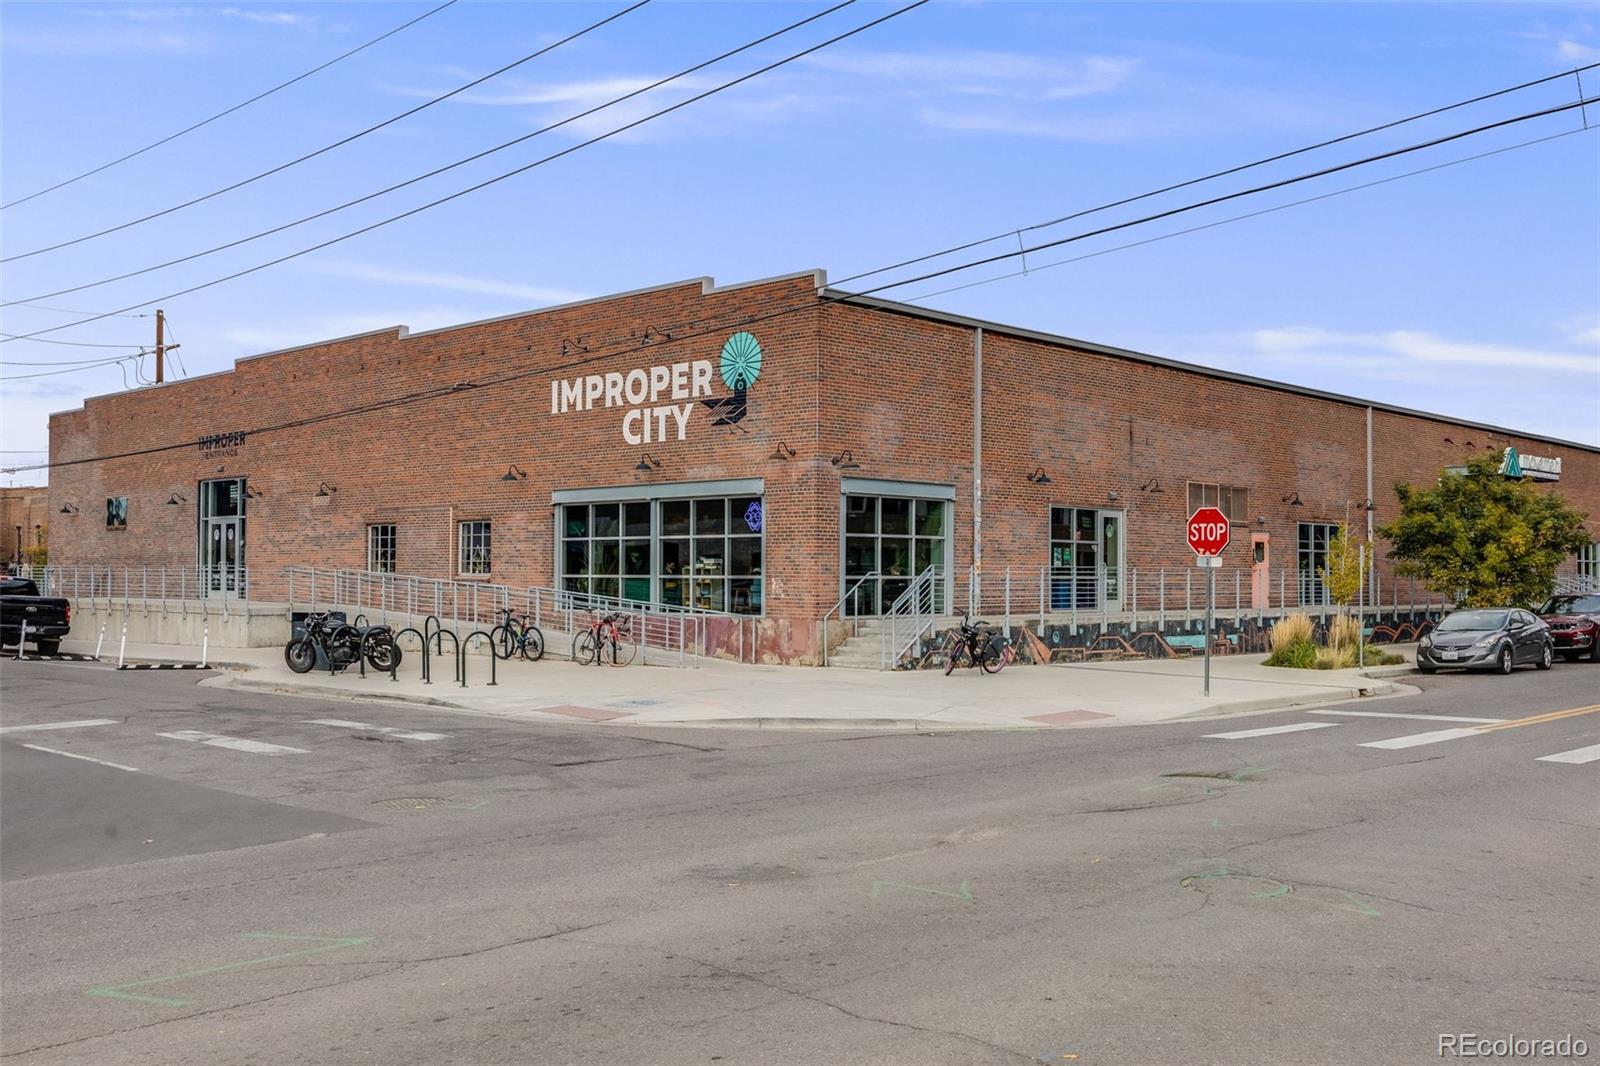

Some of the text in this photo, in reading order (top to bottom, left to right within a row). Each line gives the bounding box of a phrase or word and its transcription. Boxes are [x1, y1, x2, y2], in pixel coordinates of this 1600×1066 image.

[551, 360, 713, 414] IMPROPER
[622, 403, 693, 445] CITY
[1190, 523, 1226, 541] STOP
